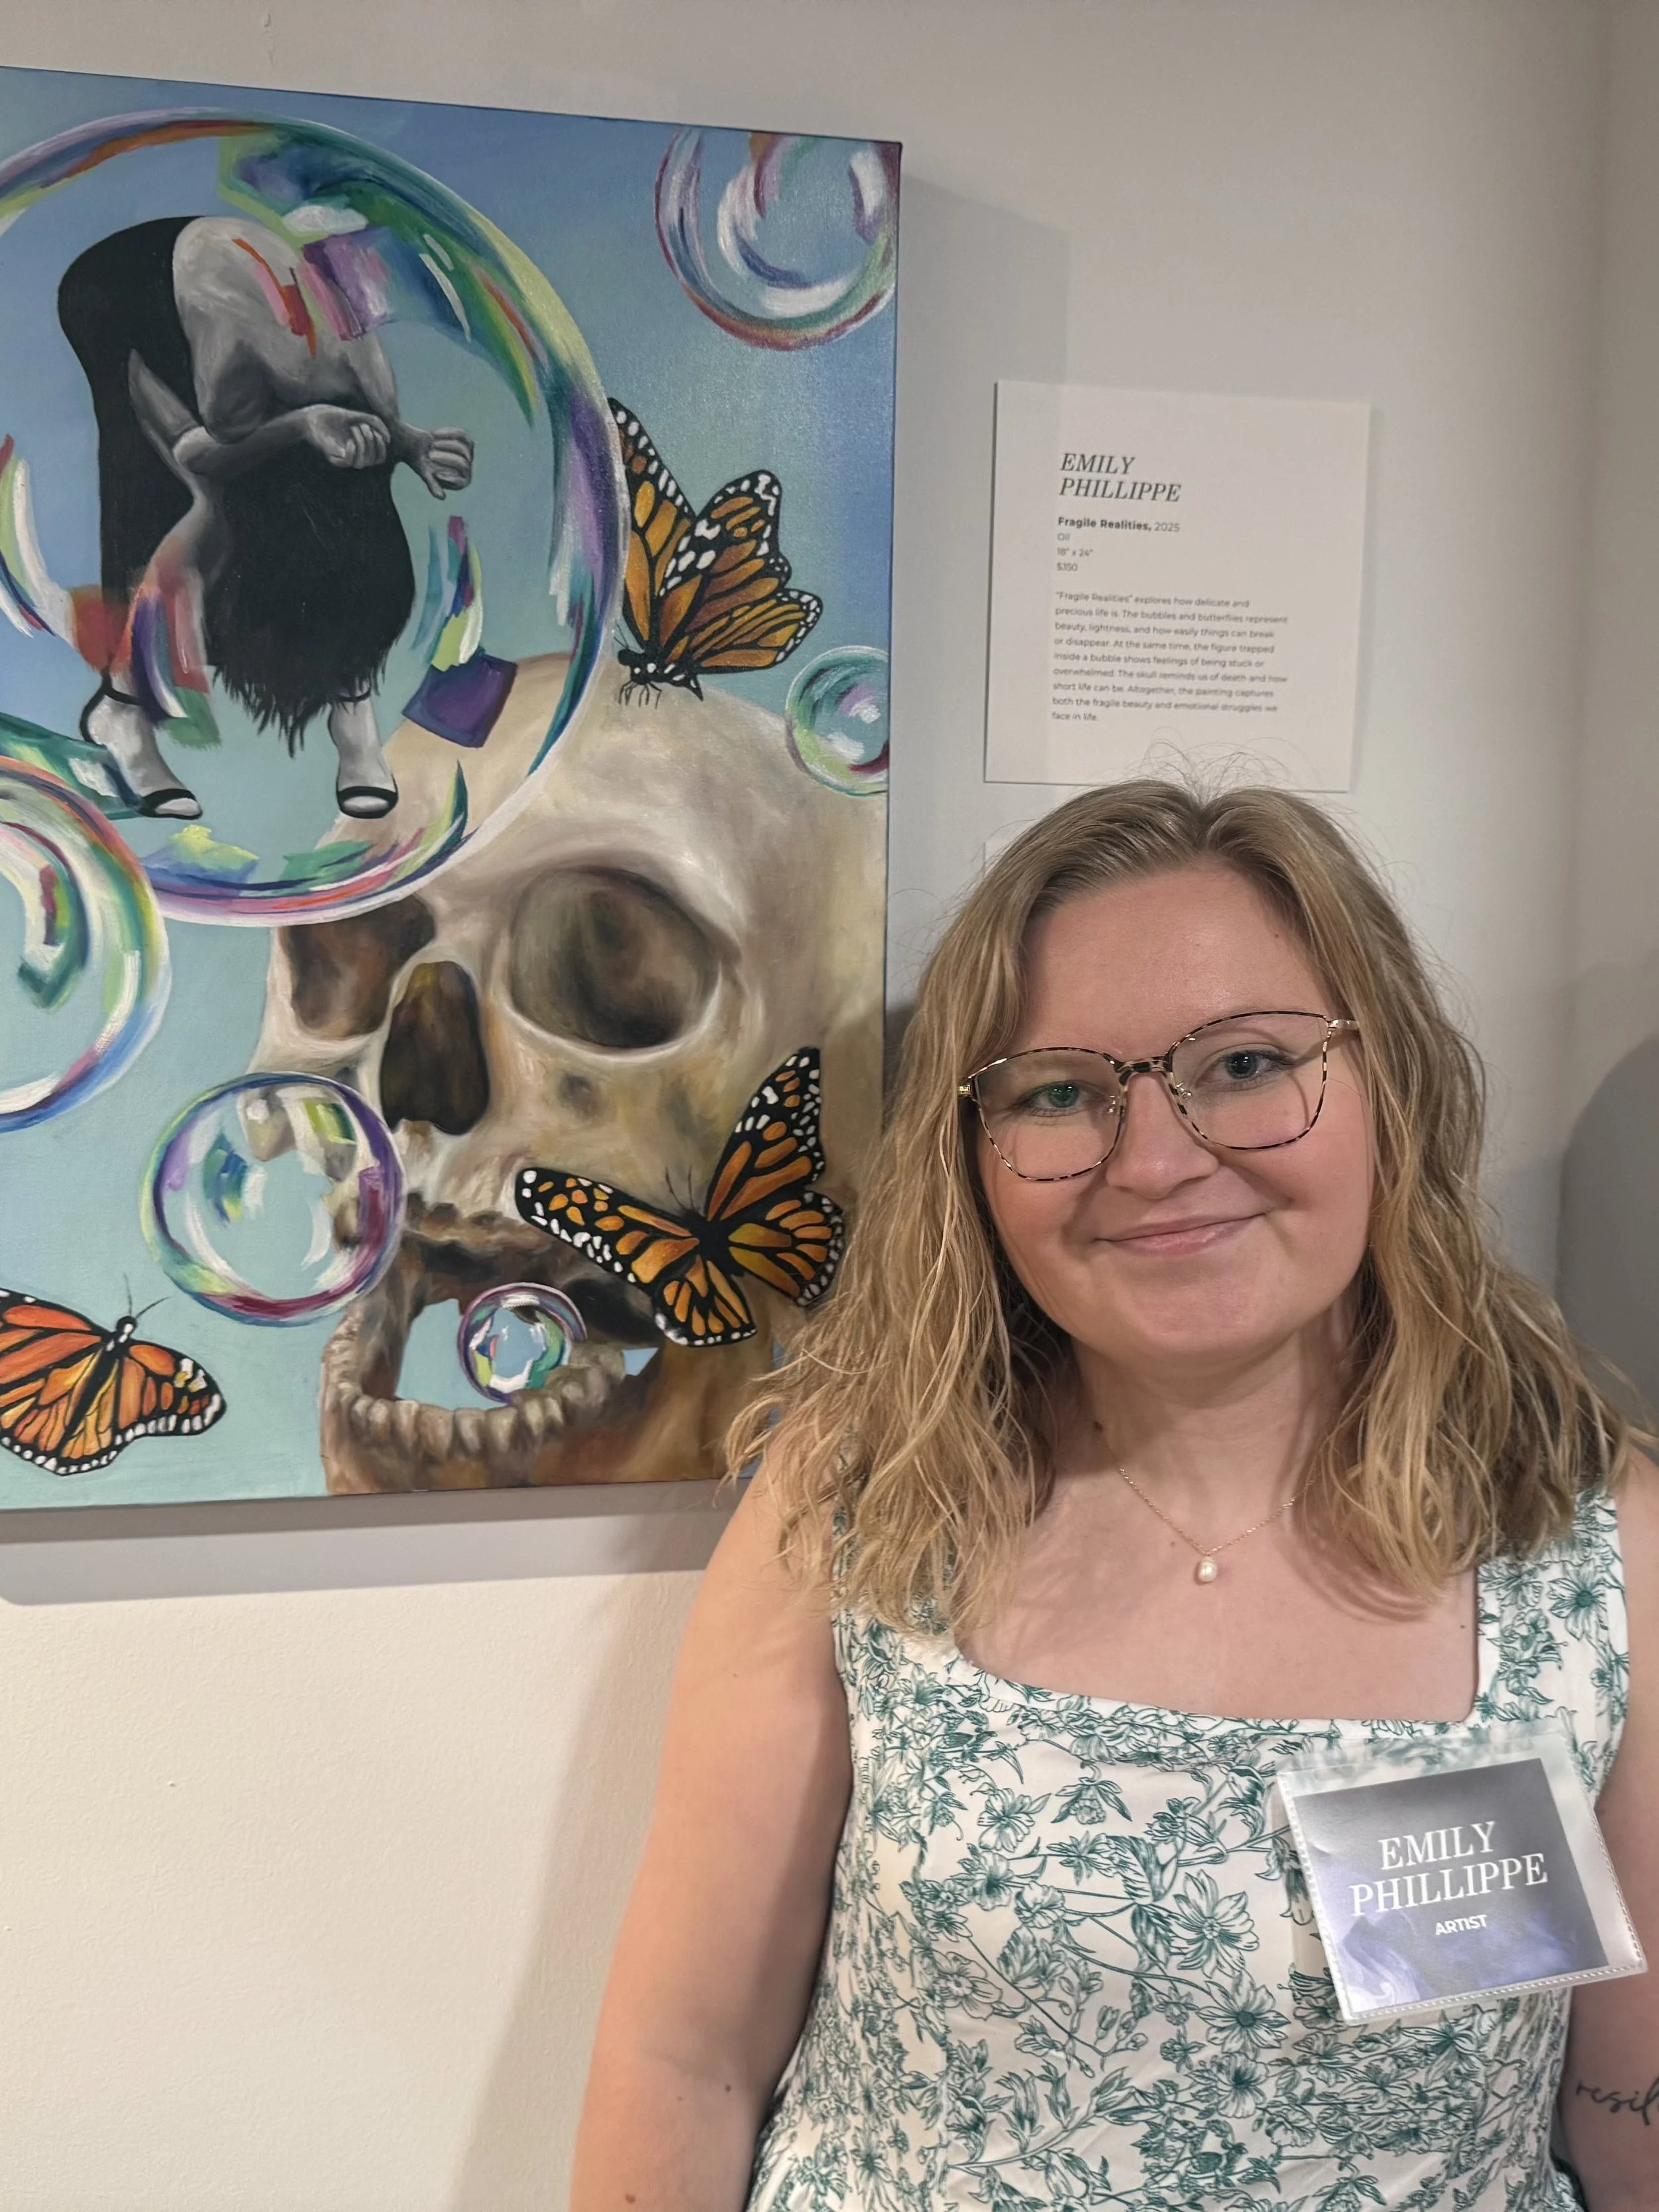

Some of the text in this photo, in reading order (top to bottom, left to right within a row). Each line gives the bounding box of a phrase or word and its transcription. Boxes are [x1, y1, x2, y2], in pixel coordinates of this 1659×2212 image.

[1060, 453, 1136, 475] EMILY
[1058, 478, 1182, 502] PHILLIPPE
[1058, 516, 1181, 532] Fragile Realities, 2025
[1057, 533, 1070, 542] Oil
[1056, 562, 1078, 571] $350
[1134, 597, 1172, 605] explores
[1194, 598, 1230, 607] delicate
[1055, 608, 1093, 617] precious
[1179, 613, 1195, 621] and
[1198, 613, 1244, 623] butterflies
[1054, 622, 1086, 632] beauty,
[1173, 628, 1198, 637] easily
[1200, 628, 1229, 638] things
[1168, 642, 1192, 651] time,
[1210, 643, 1237, 654] figure
[1239, 644, 1275, 654] trapped
[1090, 654, 1121, 662] bubble
[1123, 655, 1151, 664] shows
[1153, 656, 1188, 667] feelings
[1190, 657, 1199, 666] of
[1201, 658, 1226, 668] being
[1118, 669, 1134, 678] The
[1159, 672, 1195, 681] reminds
[1220, 674, 1247, 682] death
[1268, 674, 1287, 683] how
[1195, 688, 1233, 698] painting
[1092, 699, 1121, 708] fragile
[1122, 700, 1153, 710] beauty
[1221, 704, 1263, 713] struggles
[1051, 711, 1070, 720] face
[1378, 1821, 1496, 1870] EMILY
[1348, 1852, 1548, 1917] PHILLIPPE
[1435, 1914, 1487, 1935] ARTIST
[1575, 2075, 1659, 2126] resil
